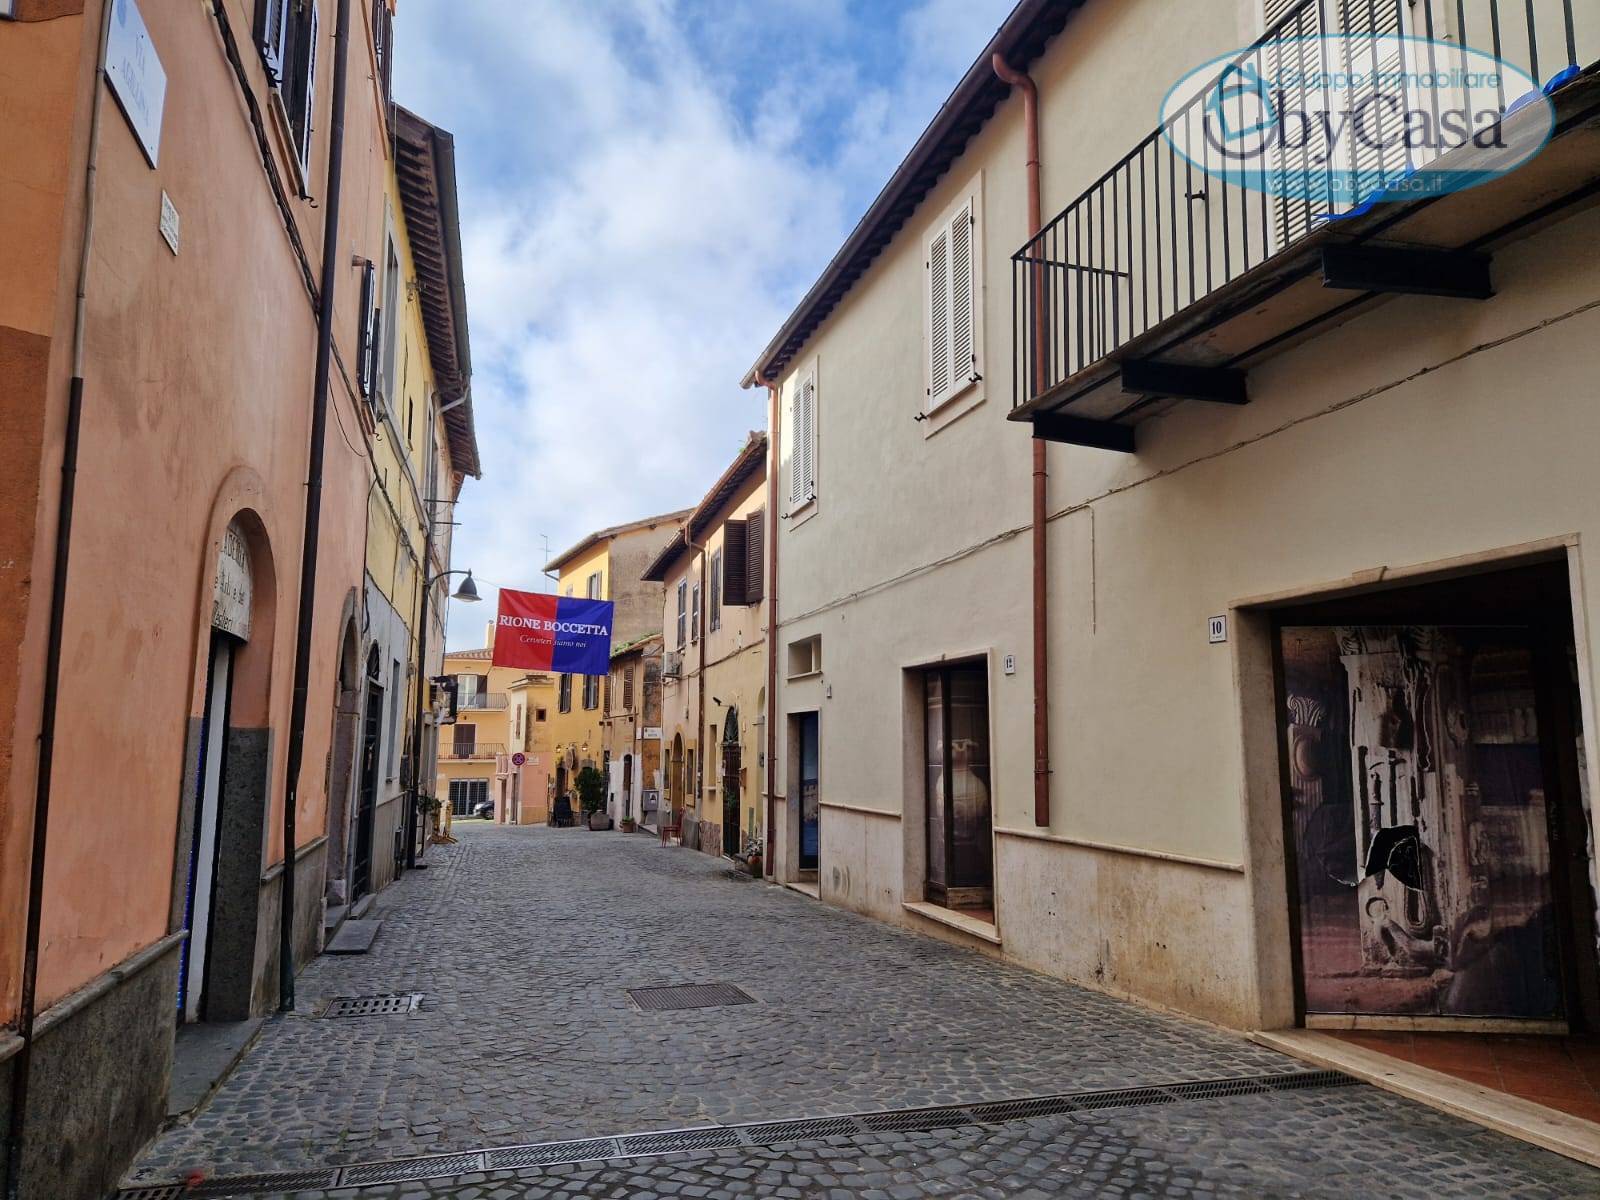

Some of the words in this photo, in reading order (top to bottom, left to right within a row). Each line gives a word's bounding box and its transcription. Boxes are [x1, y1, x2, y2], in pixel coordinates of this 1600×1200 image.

[499, 615, 540, 629] RIONE
[543, 620, 609, 636] BOCCETTA
[1212, 620, 1222, 635] 10
